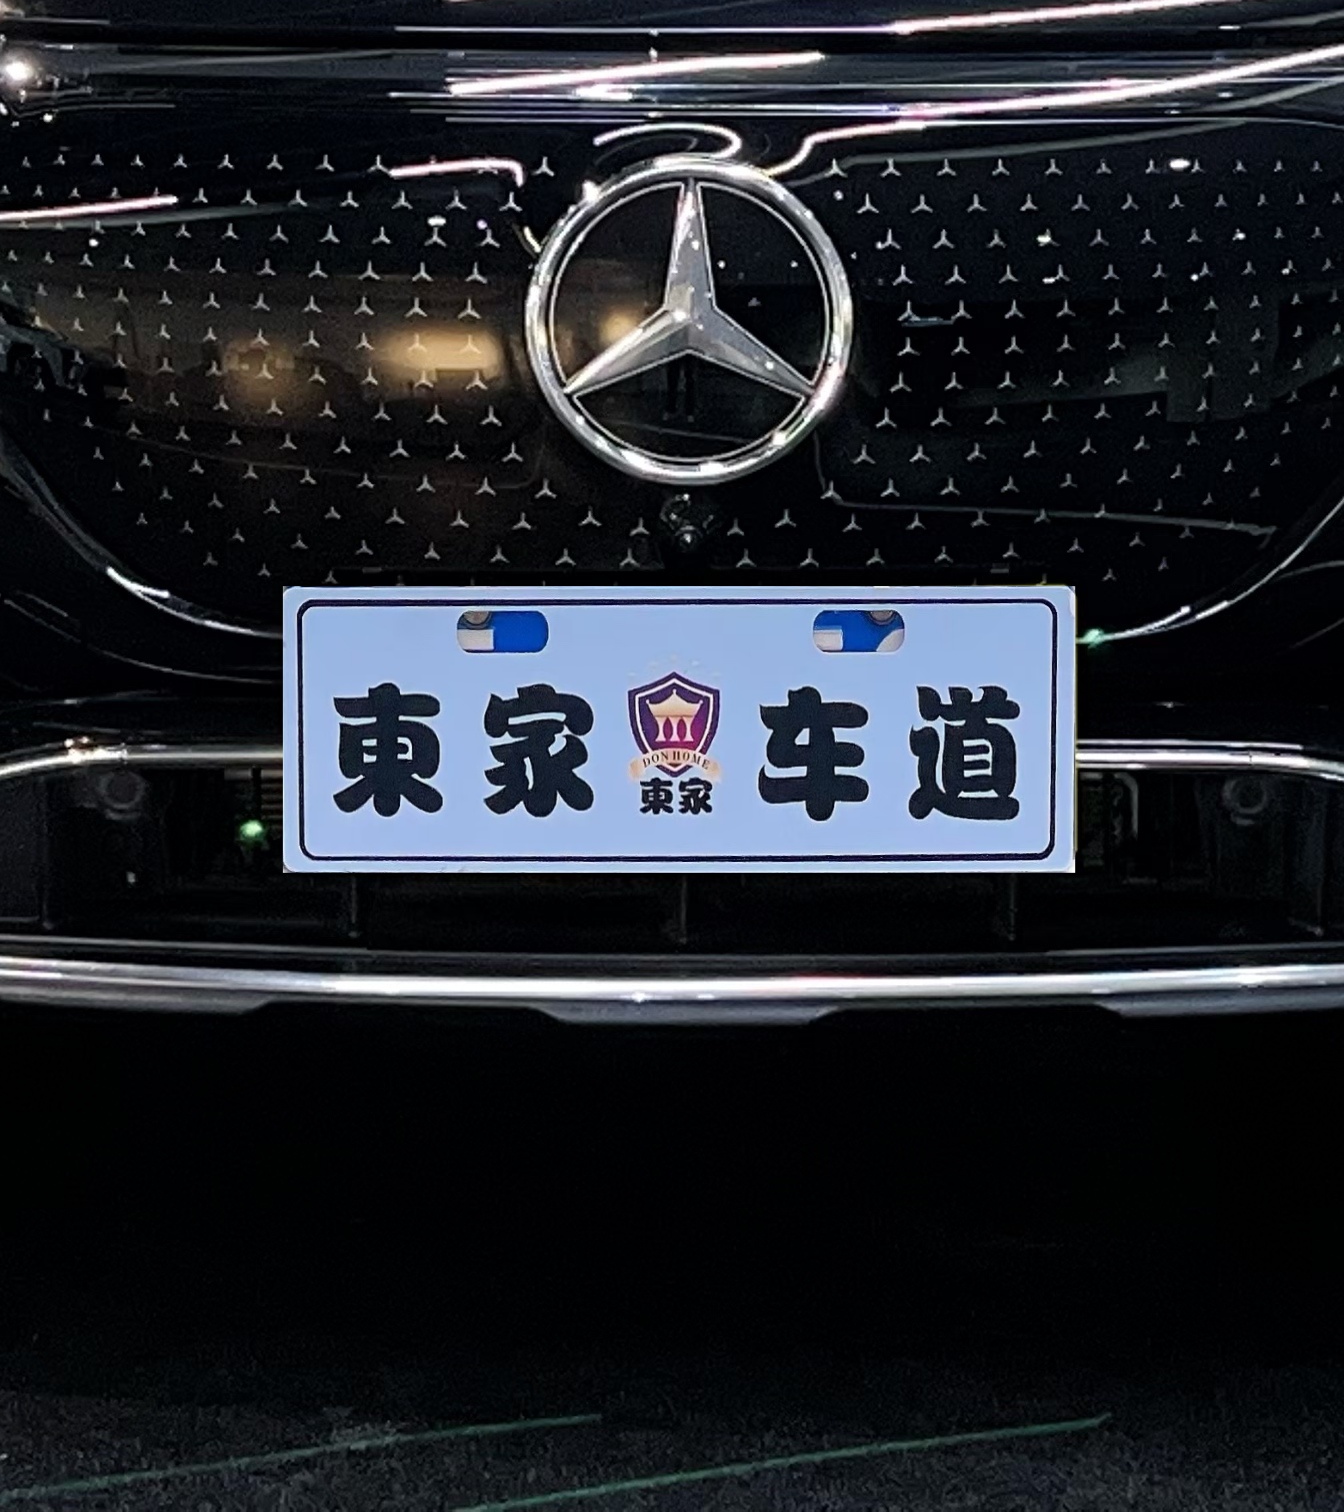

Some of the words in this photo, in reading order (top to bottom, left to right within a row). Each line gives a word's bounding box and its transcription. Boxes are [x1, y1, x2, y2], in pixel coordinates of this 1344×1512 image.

[334, 683, 593, 817] 東家
[759, 686, 1020, 821] 车道
[642, 750, 670, 768] DON
[672, 750, 710, 770] HOME
[639, 777, 713, 815] 東家
